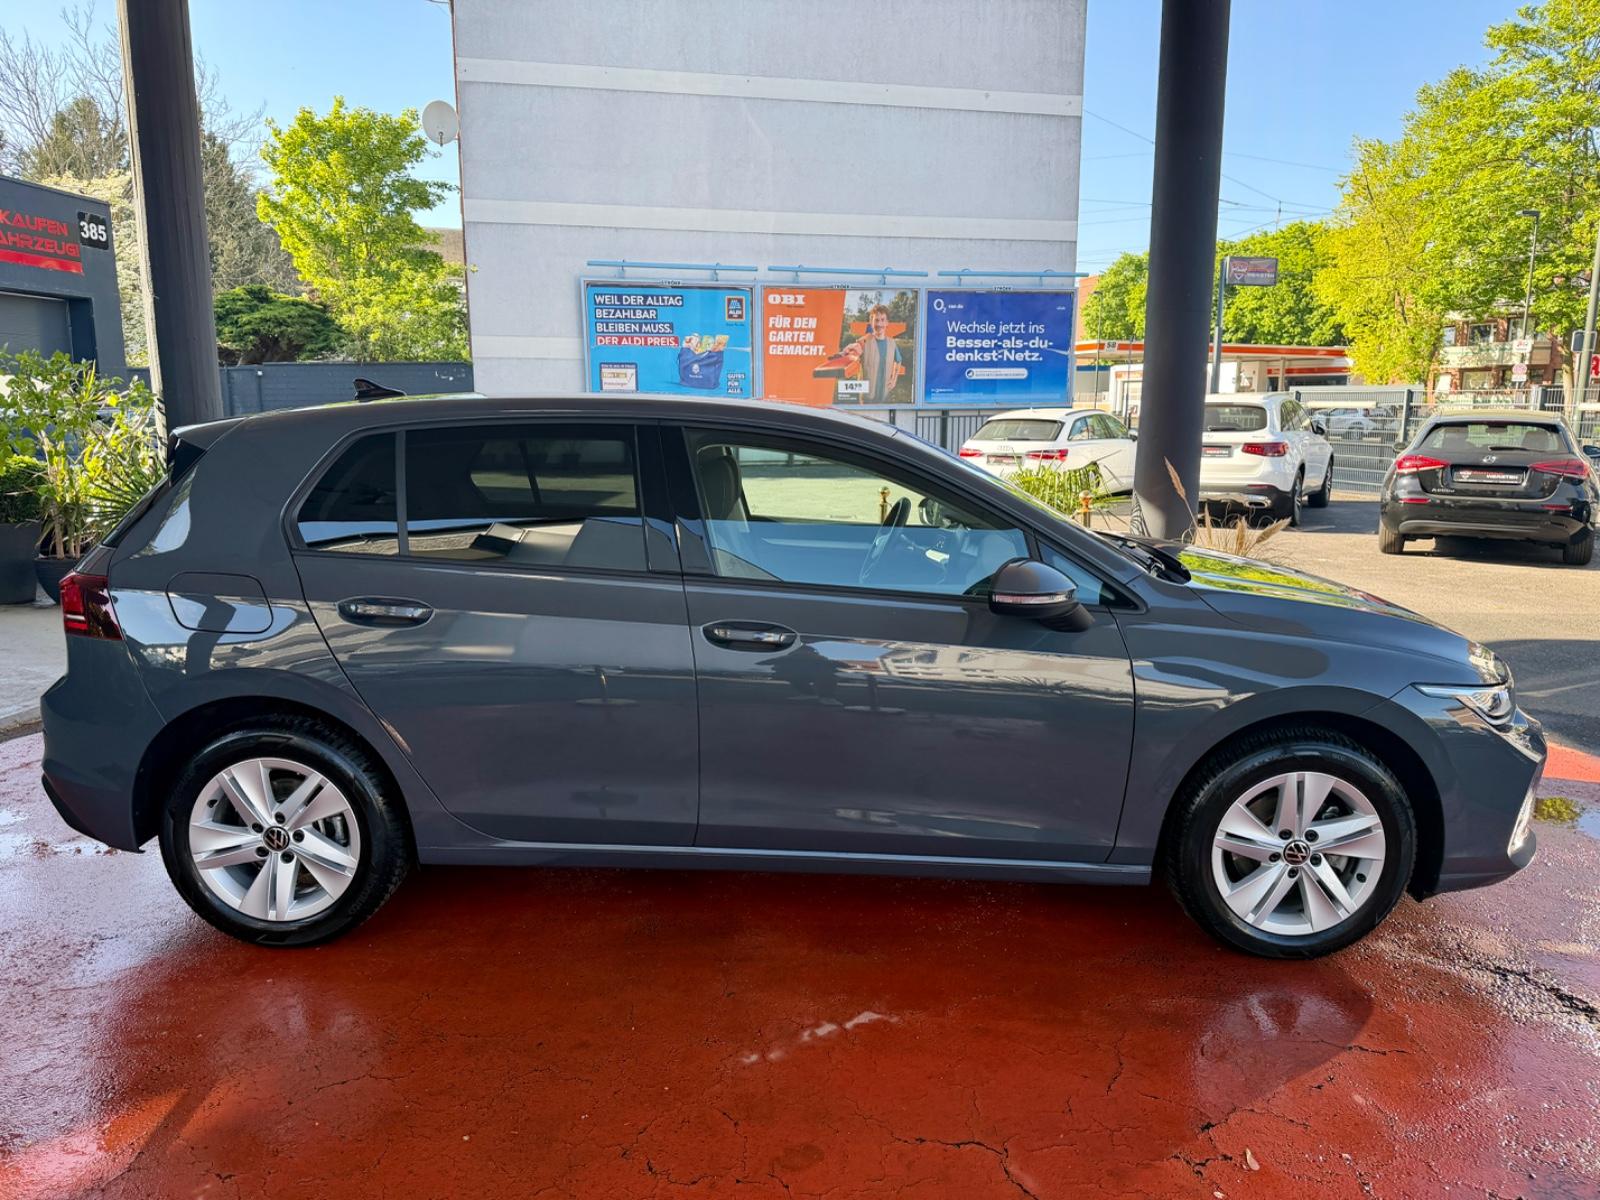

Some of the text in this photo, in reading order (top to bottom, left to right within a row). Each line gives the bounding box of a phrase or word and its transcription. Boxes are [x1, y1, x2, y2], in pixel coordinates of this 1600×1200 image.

[80, 220, 107, 242] 385
[594, 294, 682, 306] WEIL DER ALLTAG
[768, 294, 805, 305] OBI
[595, 308, 656, 319] BEZAHLBAR
[768, 315, 817, 328] FÜR DEN
[596, 322, 673, 333] BLEIBEN MUSS.
[946, 320, 1045, 336] Wechsle jetzt ins
[621, 336, 645, 346] ALDI
[647, 337, 679, 346] PREIS.
[768, 331, 814, 342] GARTEN
[946, 336, 1053, 348] Besser-als-du-
[768, 345, 827, 356] GEMACHT.
[945, 350, 1043, 361] denkst-Netz.
